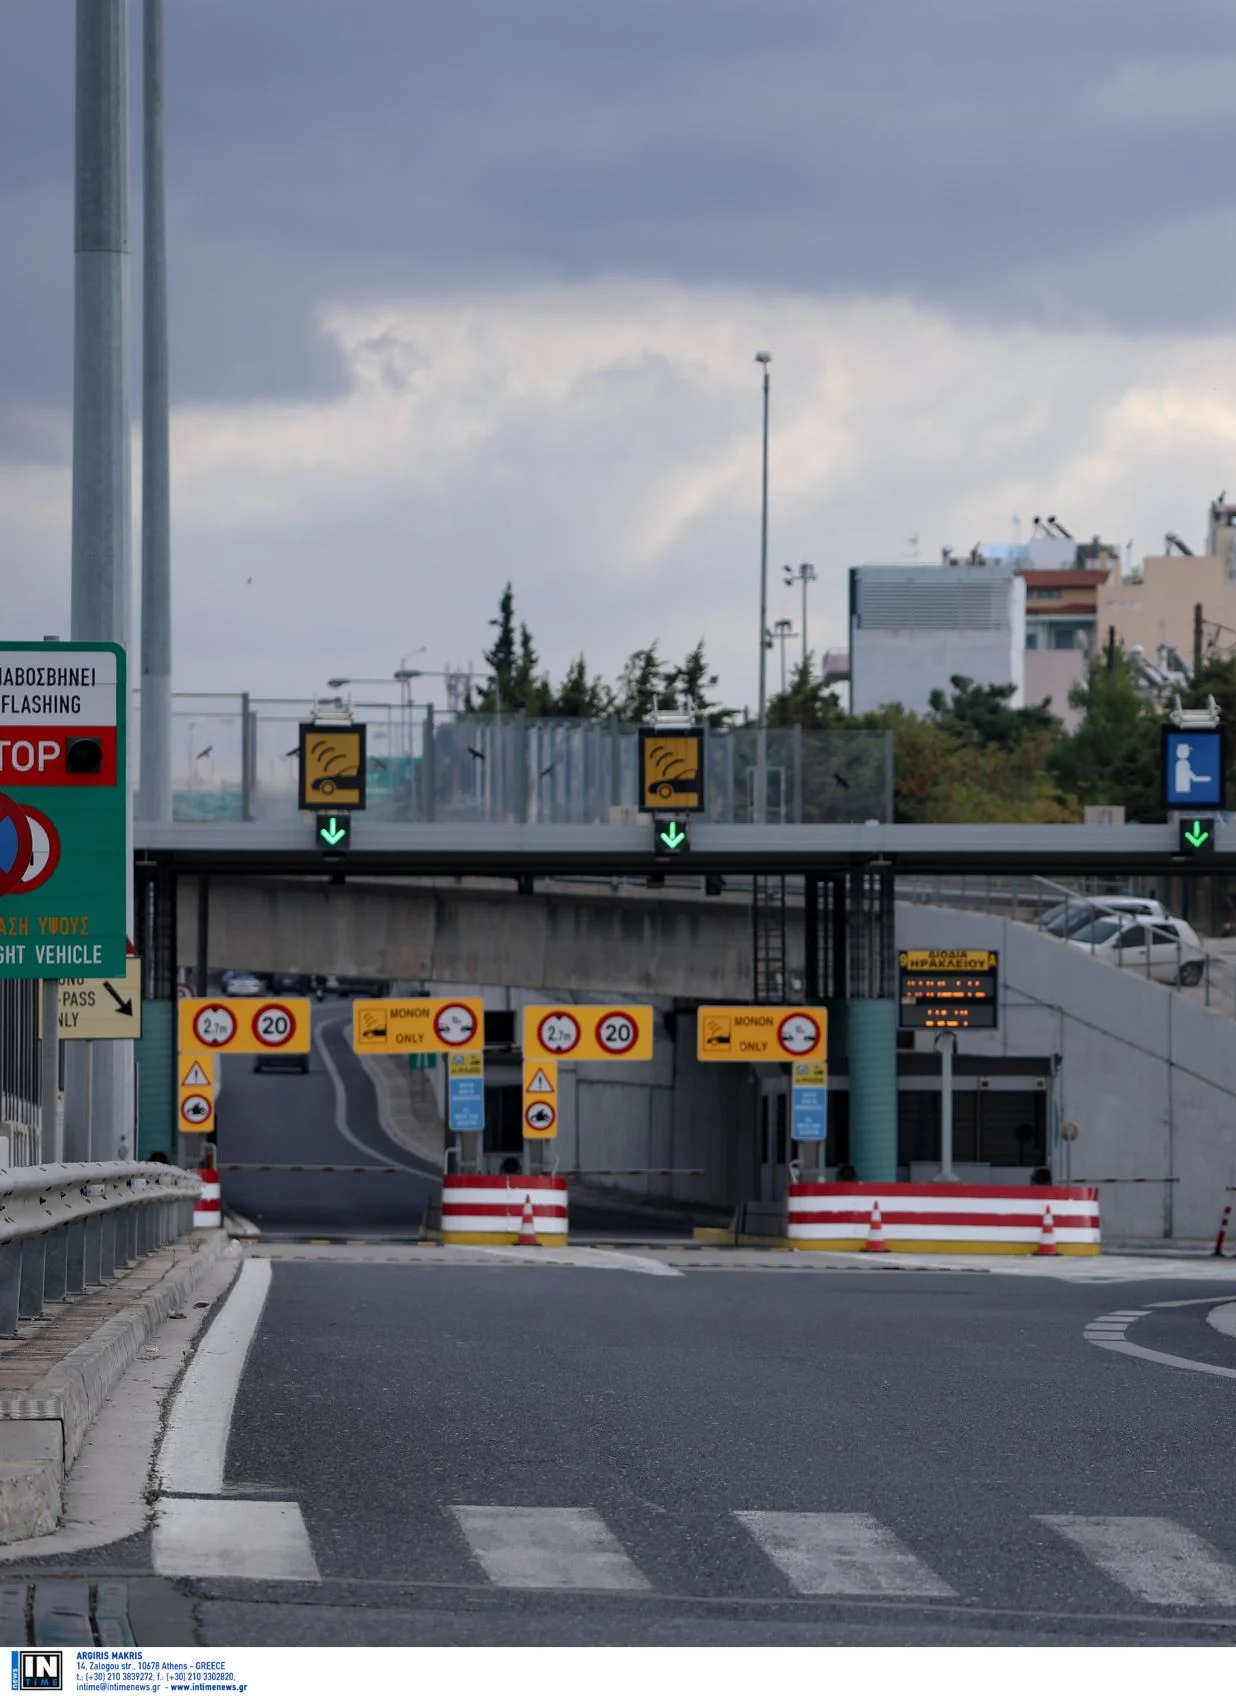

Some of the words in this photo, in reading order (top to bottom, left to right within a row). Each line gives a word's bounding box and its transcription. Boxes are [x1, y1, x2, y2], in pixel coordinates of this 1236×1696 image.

[1, 695, 81, 714] FLASHING
[38, 916, 89, 936] ΥΨΟΥΣ
[35, 944, 102, 964] VEHICLE
[262, 1016, 288, 1035] 20
[605, 1024, 631, 1042] 20
[396, 1033, 424, 1043] ONLY
[739, 1041, 768, 1051] ONLY
